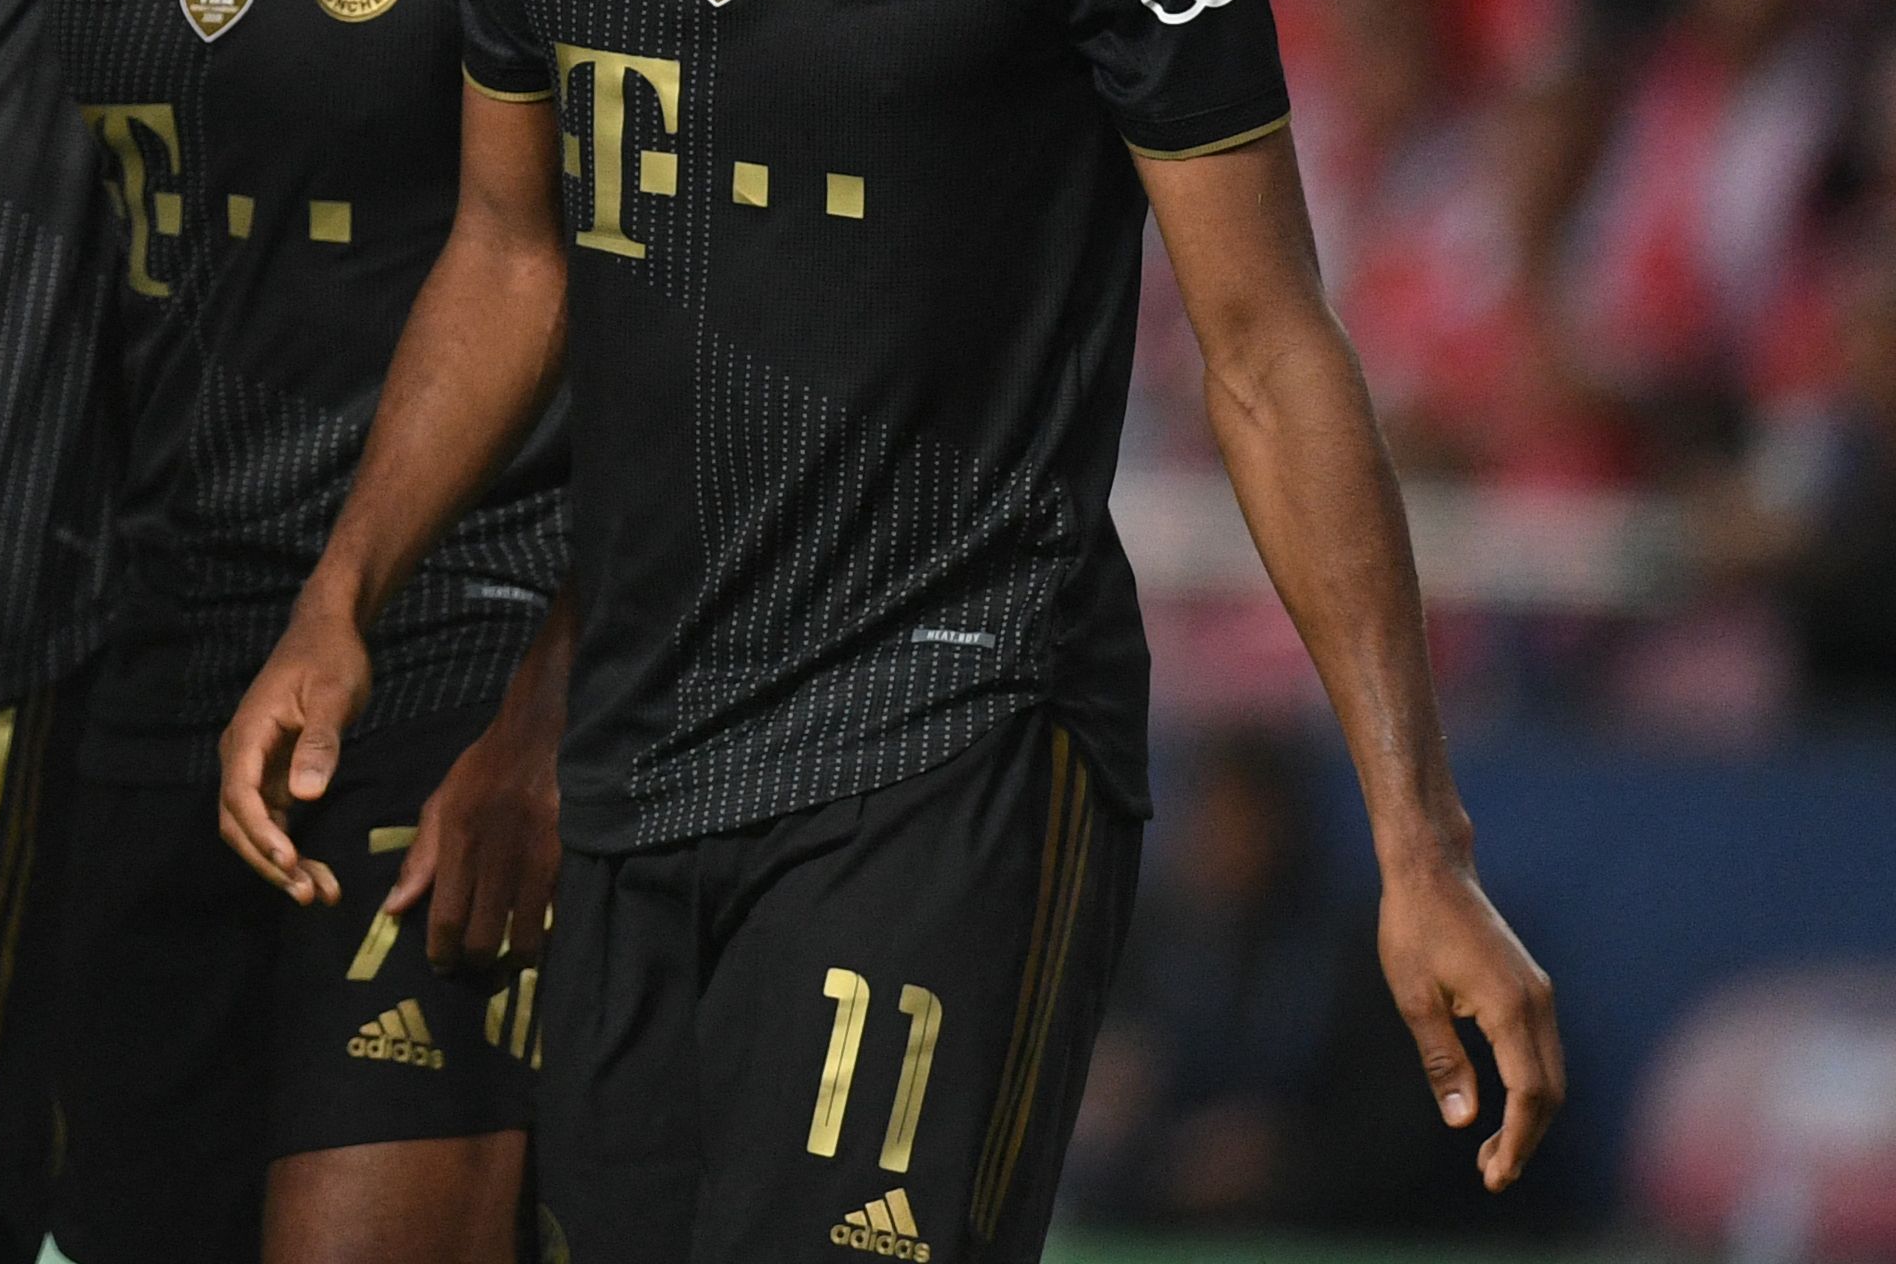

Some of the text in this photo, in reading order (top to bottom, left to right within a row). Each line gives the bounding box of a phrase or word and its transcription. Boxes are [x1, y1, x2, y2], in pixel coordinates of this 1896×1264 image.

[346, 1037, 446, 1070] adidas
[806, 967, 943, 1174] 11
[829, 1224, 932, 1263] adidas
